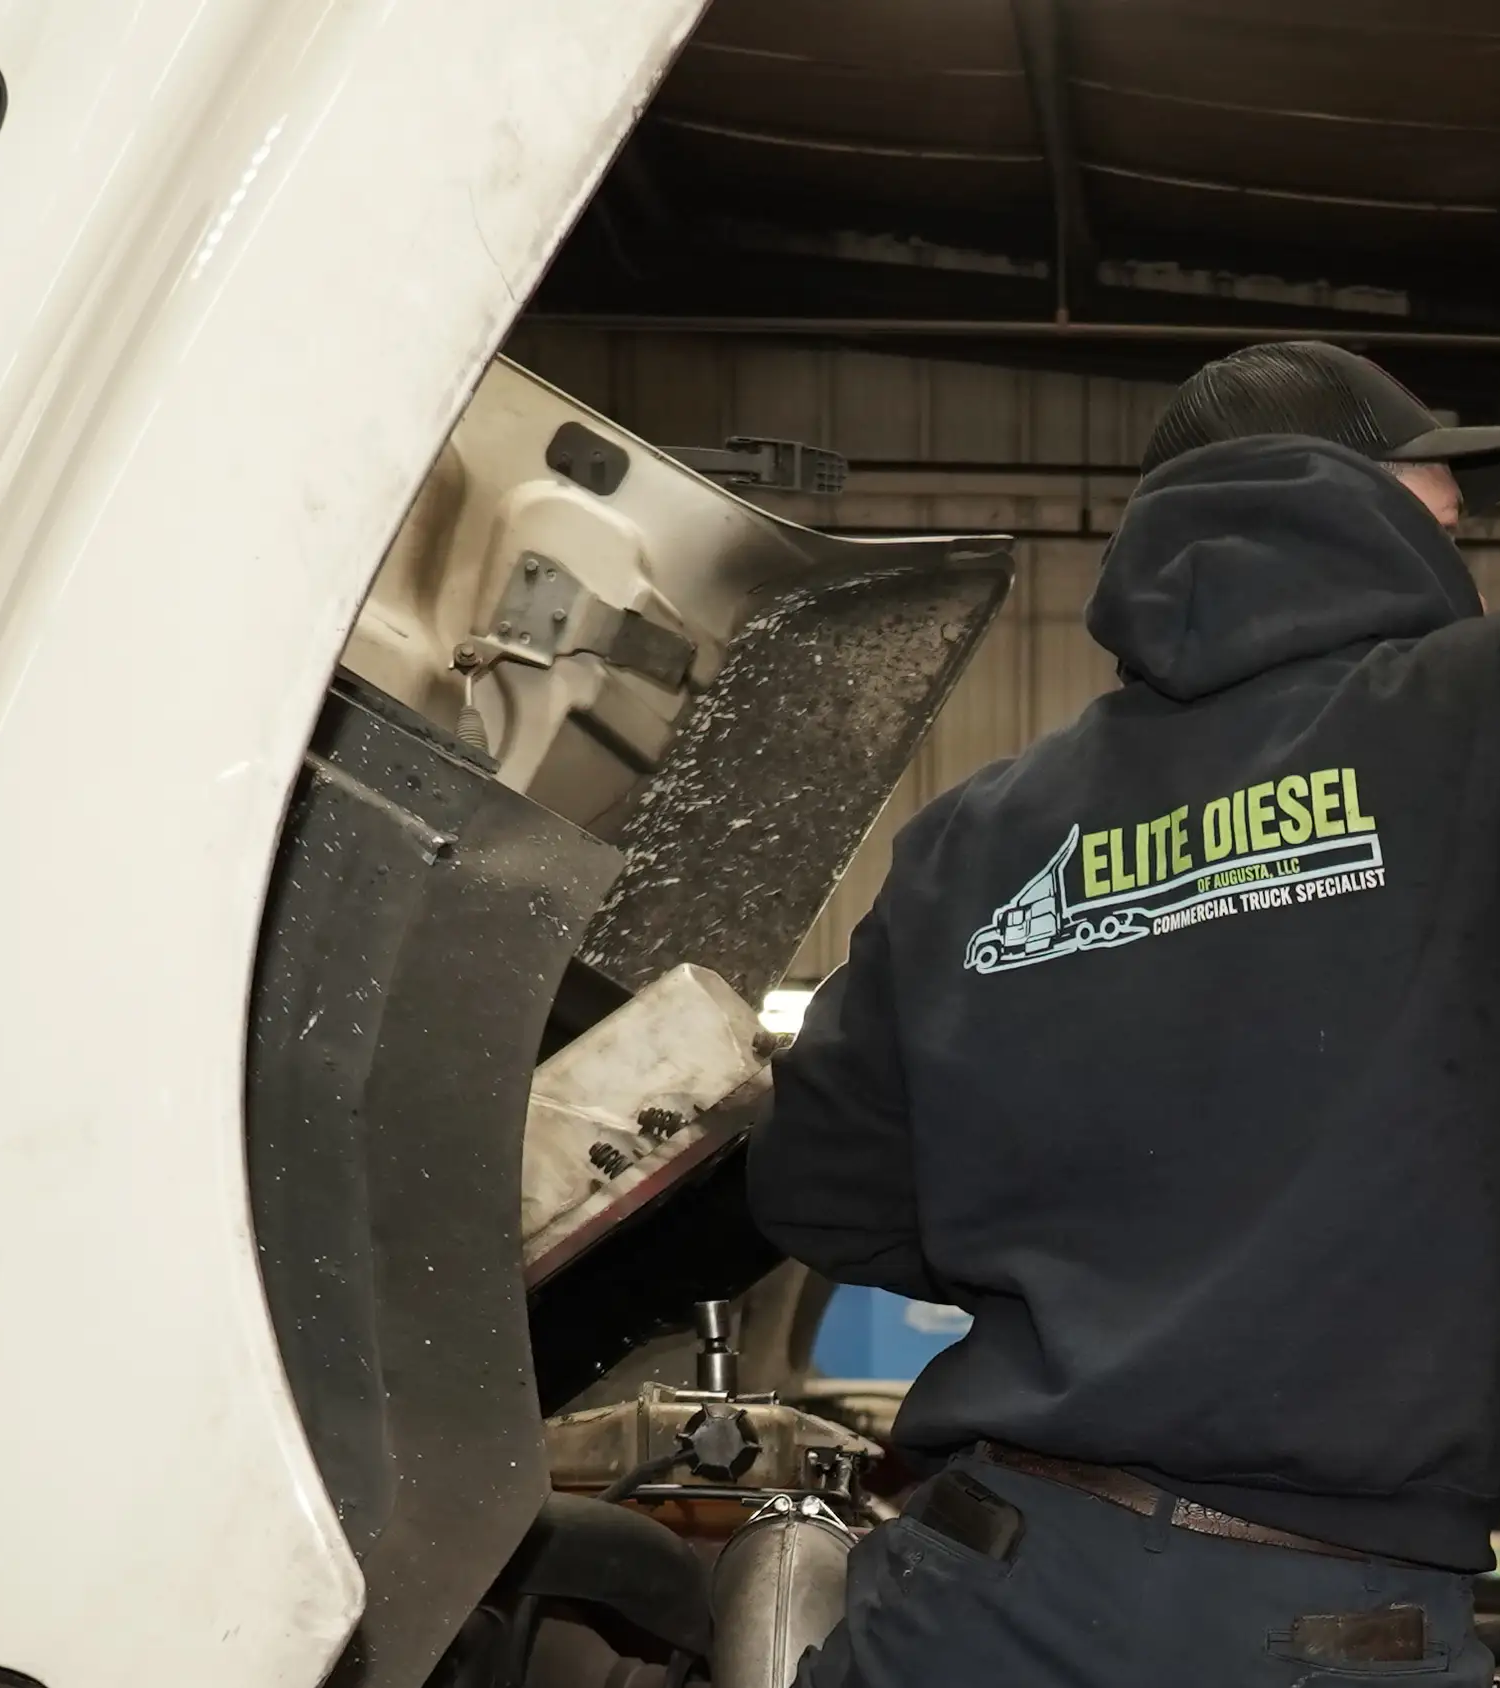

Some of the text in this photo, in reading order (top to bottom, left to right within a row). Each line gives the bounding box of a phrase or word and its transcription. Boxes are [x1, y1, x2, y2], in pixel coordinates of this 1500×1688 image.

[1082, 768, 1376, 898] ELITE DIESEL
[1153, 868, 1386, 937] COMMERCIAL TRUCK SPECIALIST
[1198, 858, 1300, 894] OF AUGUSTA, LLC
